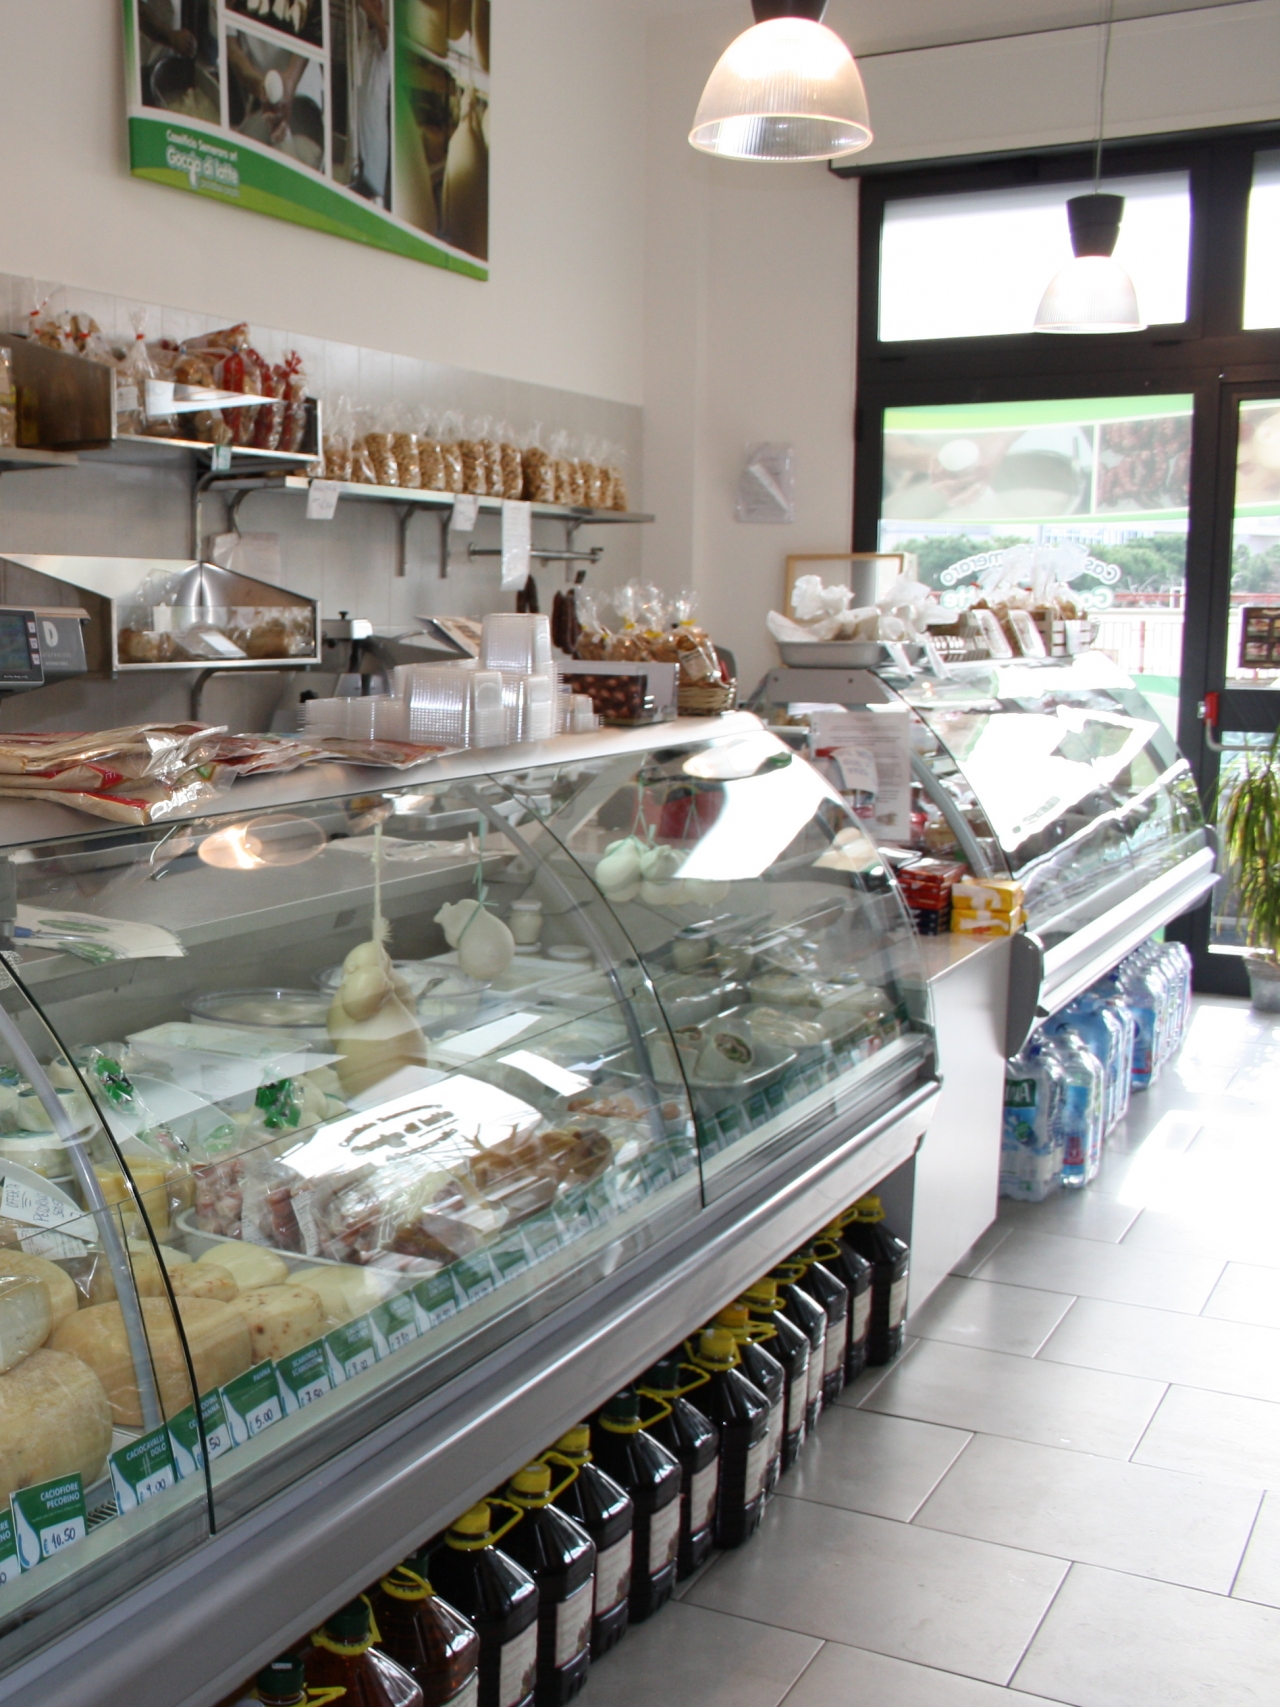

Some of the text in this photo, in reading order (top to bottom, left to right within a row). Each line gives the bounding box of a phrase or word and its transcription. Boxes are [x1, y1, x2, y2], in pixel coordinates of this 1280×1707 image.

[255, 1408, 274, 1429] 5.00
[40, 1482, 79, 1501] CACIOFIORE
[46, 1492, 80, 1510] PECORINO
[51, 1527, 76, 1550] 10.50
